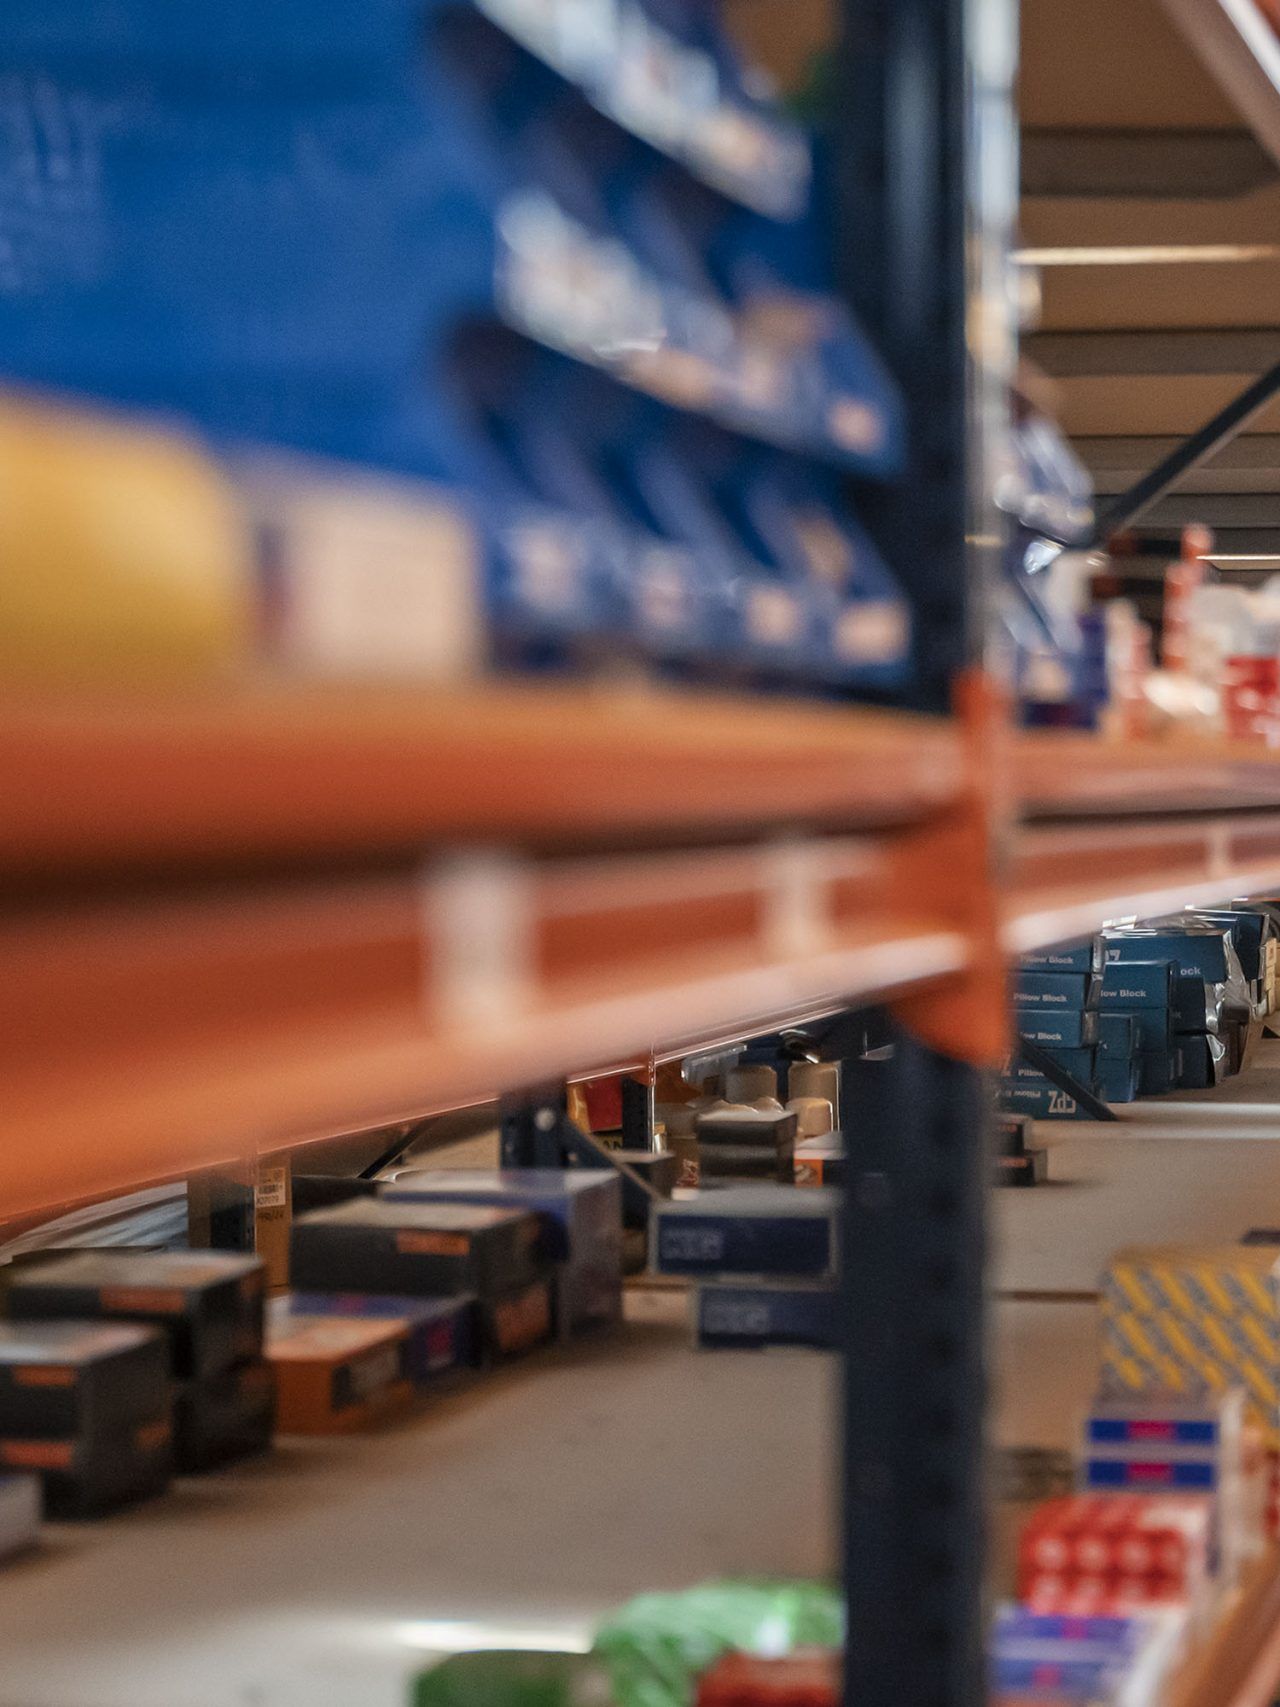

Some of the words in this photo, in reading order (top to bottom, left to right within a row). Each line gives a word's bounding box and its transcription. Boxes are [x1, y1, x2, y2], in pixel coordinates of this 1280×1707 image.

[1049, 955, 1074, 964] Block
[1180, 967, 1201, 976] ock
[1013, 992, 1041, 1001] Pillow
[1042, 993, 1068, 1002] Block
[1101, 989, 1117, 997] low
[1120, 989, 1147, 997] Block
[1037, 1031, 1062, 1040] Block
